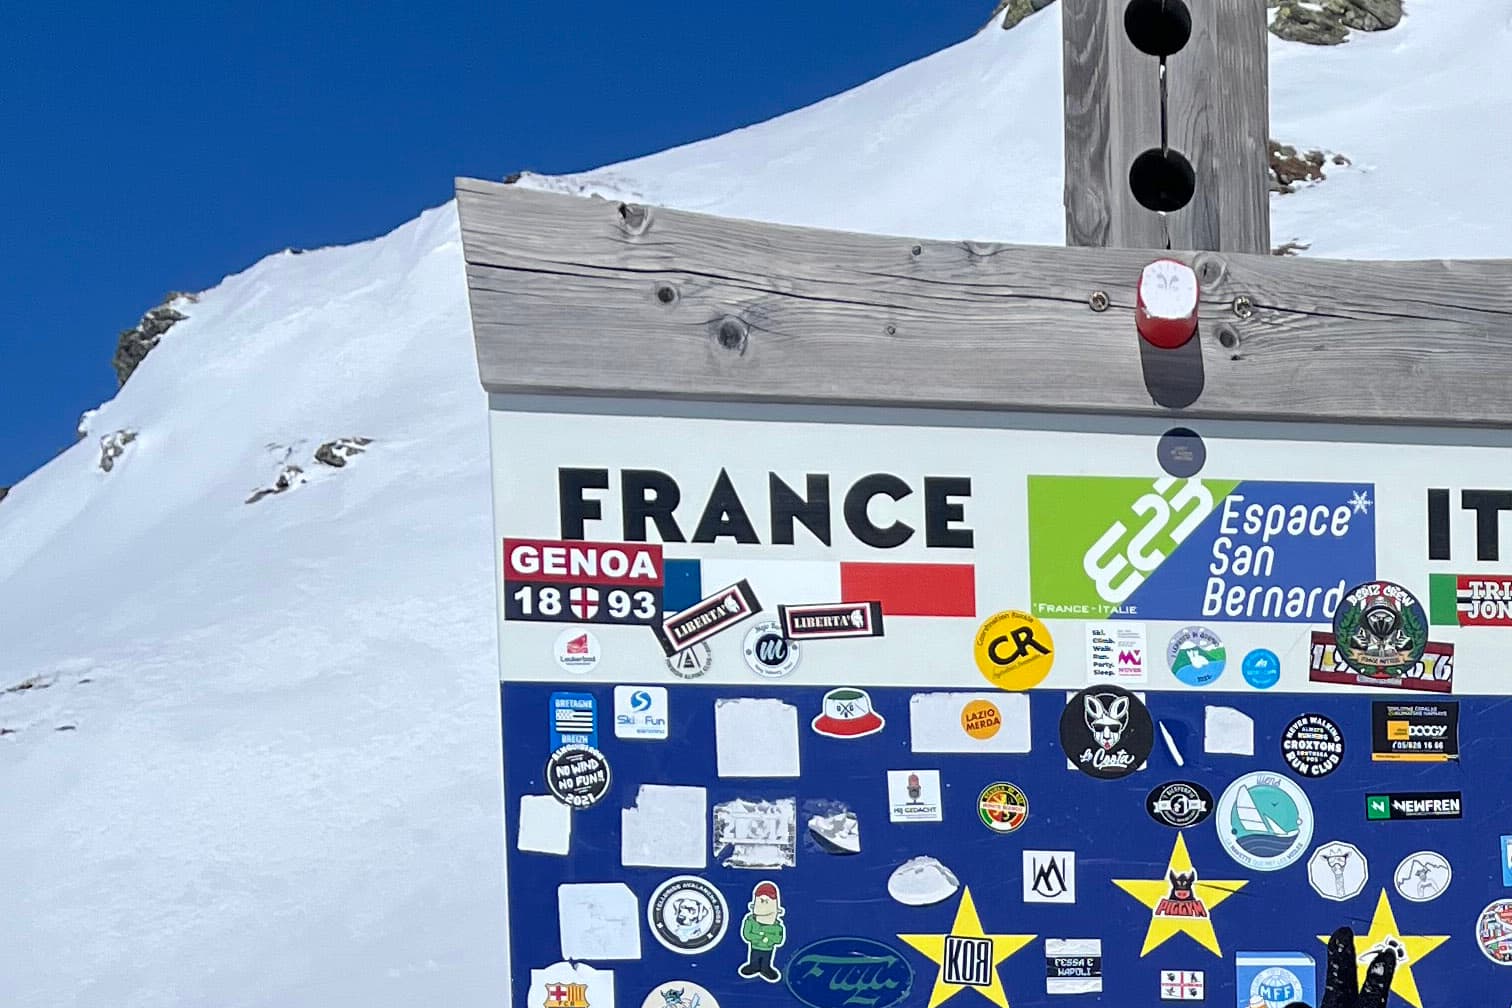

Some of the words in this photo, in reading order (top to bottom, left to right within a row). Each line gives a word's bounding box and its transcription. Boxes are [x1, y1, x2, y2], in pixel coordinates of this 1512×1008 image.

[558, 467, 974, 548] FRANCE
[1220, 495, 1350, 542] Espace
[510, 545, 657, 579] GENOA
[1209, 538, 1275, 576] San
[514, 587, 561, 615] 18
[608, 590, 656, 618] 93
[1384, 585, 1414, 607] CREW
[988, 627, 1052, 666] CR
[555, 699, 593, 708] BRETAGNE
[965, 709, 995, 721] LAZIO
[966, 716, 1000, 732] MERDA
[1310, 716, 1341, 742] WALKING
[1283, 740, 1342, 752] CROXTONS
[572, 759, 599, 773] WIND
[1285, 750, 1309, 775] RUN
[1311, 755, 1340, 776] CLUB
[1392, 798, 1460, 813] NEWFREN
[1260, 986, 1291, 1001] MFF
